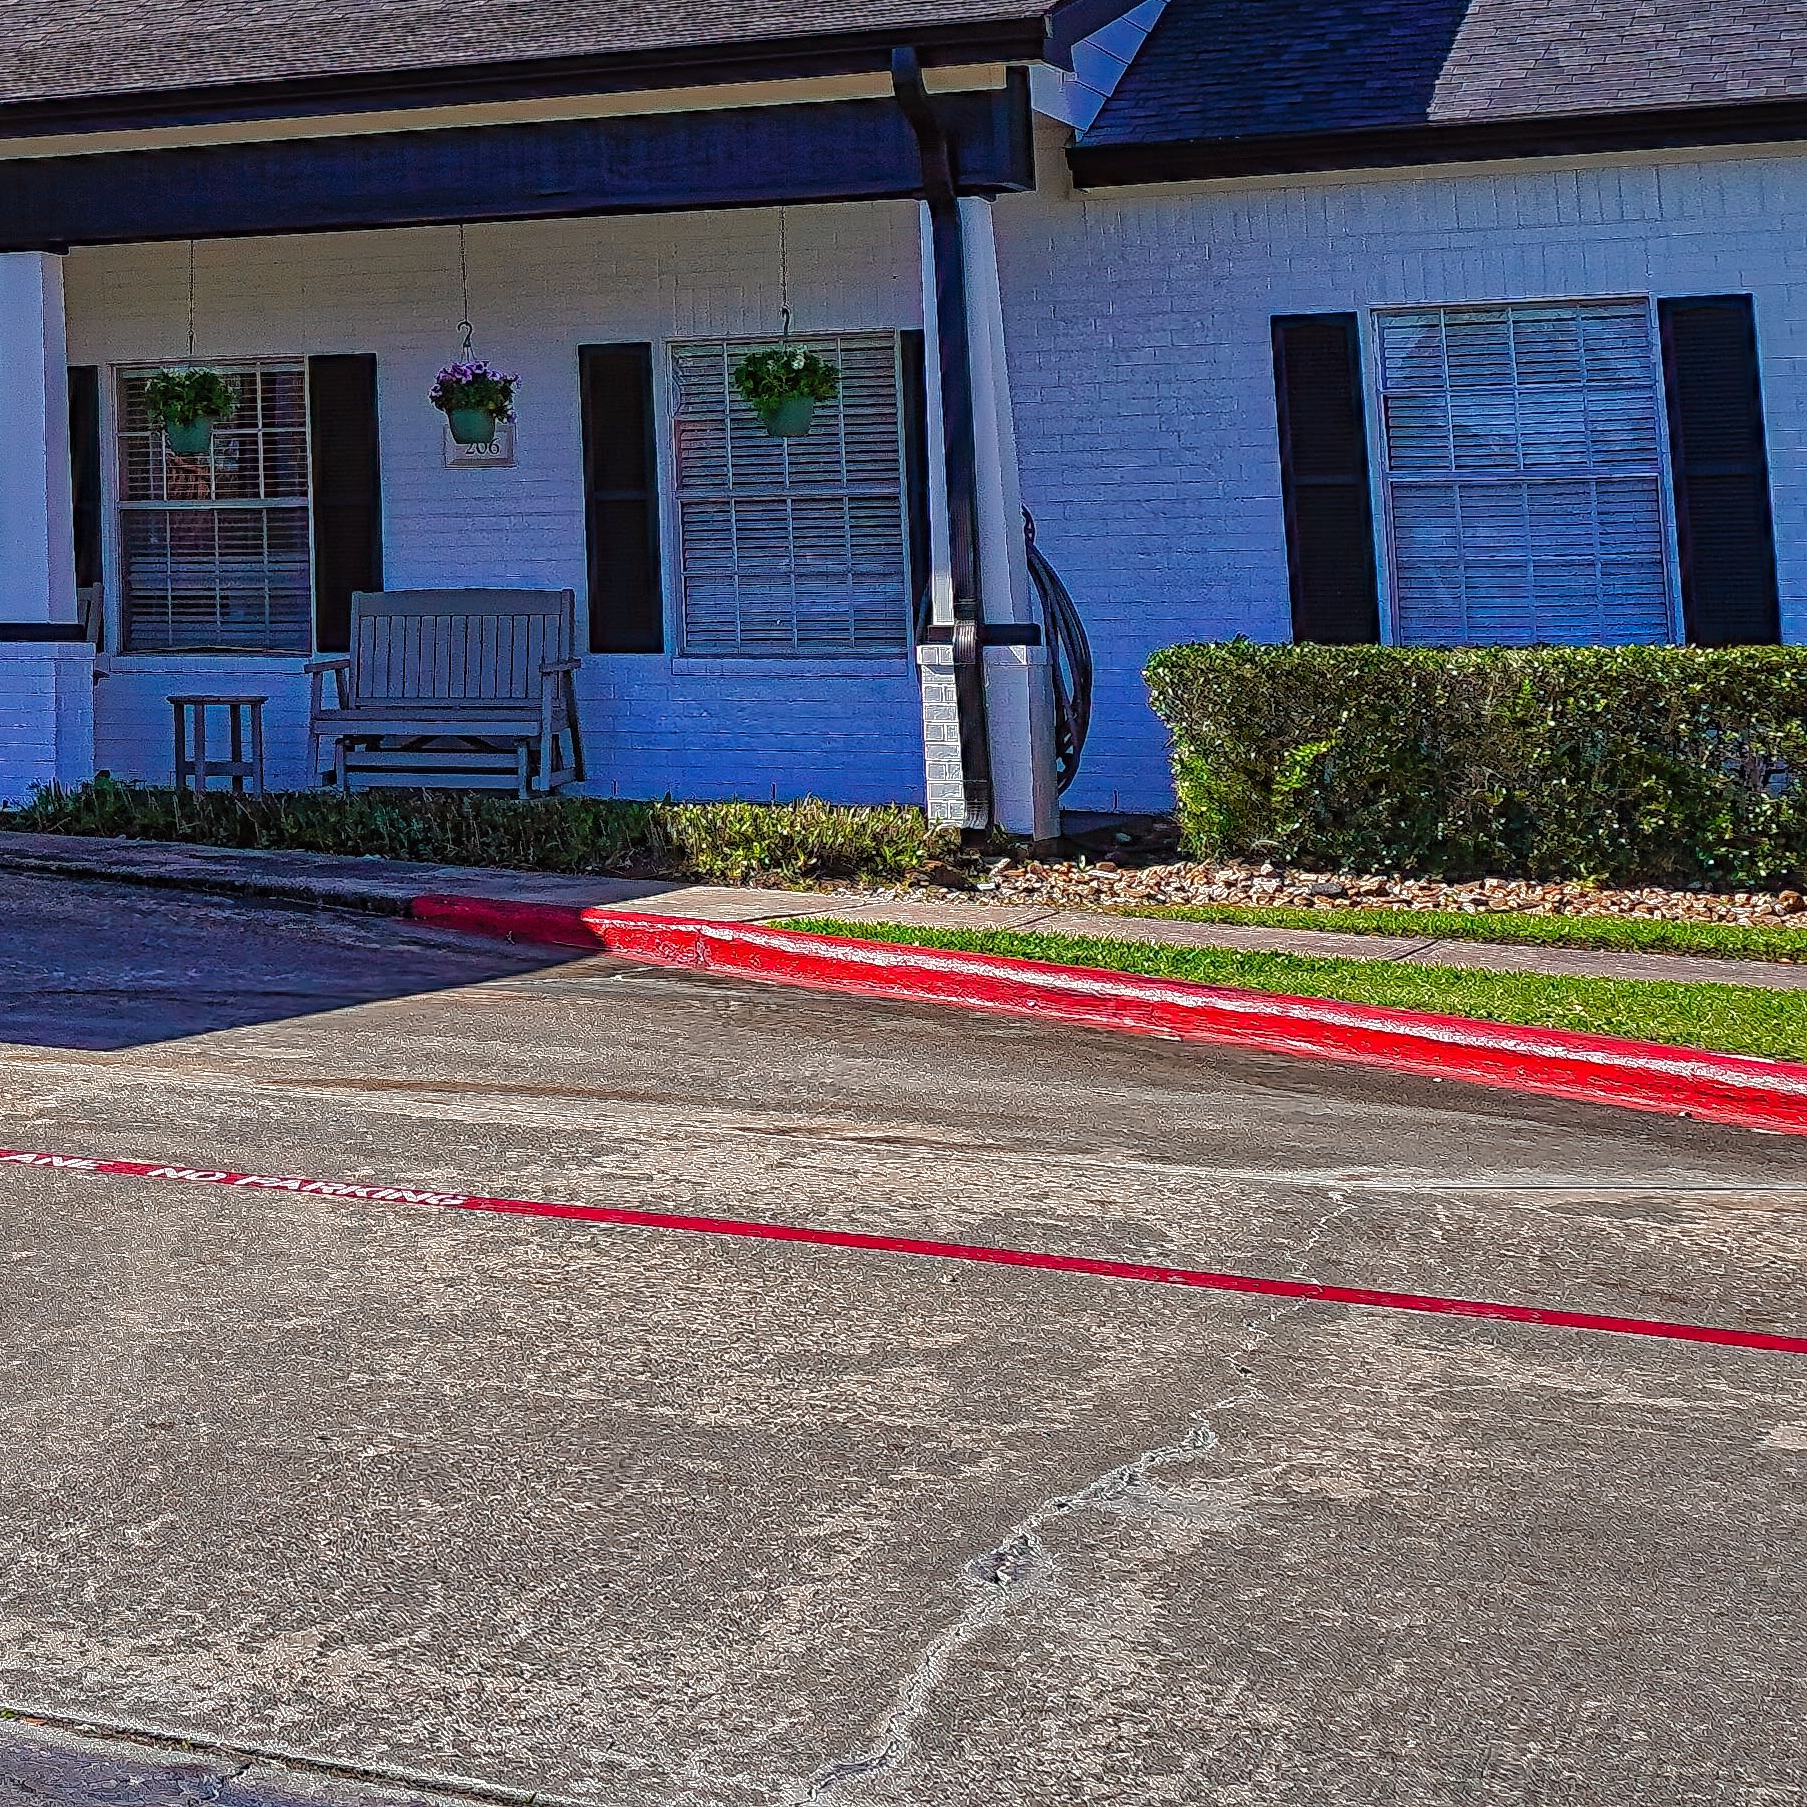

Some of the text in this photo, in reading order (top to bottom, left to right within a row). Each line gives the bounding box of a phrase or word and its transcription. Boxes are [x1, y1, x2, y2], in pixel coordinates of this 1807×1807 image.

[466, 437, 500, 455] 206
[147, 1167, 227, 1182] NO
[233, 1175, 466, 1206] PARKING
